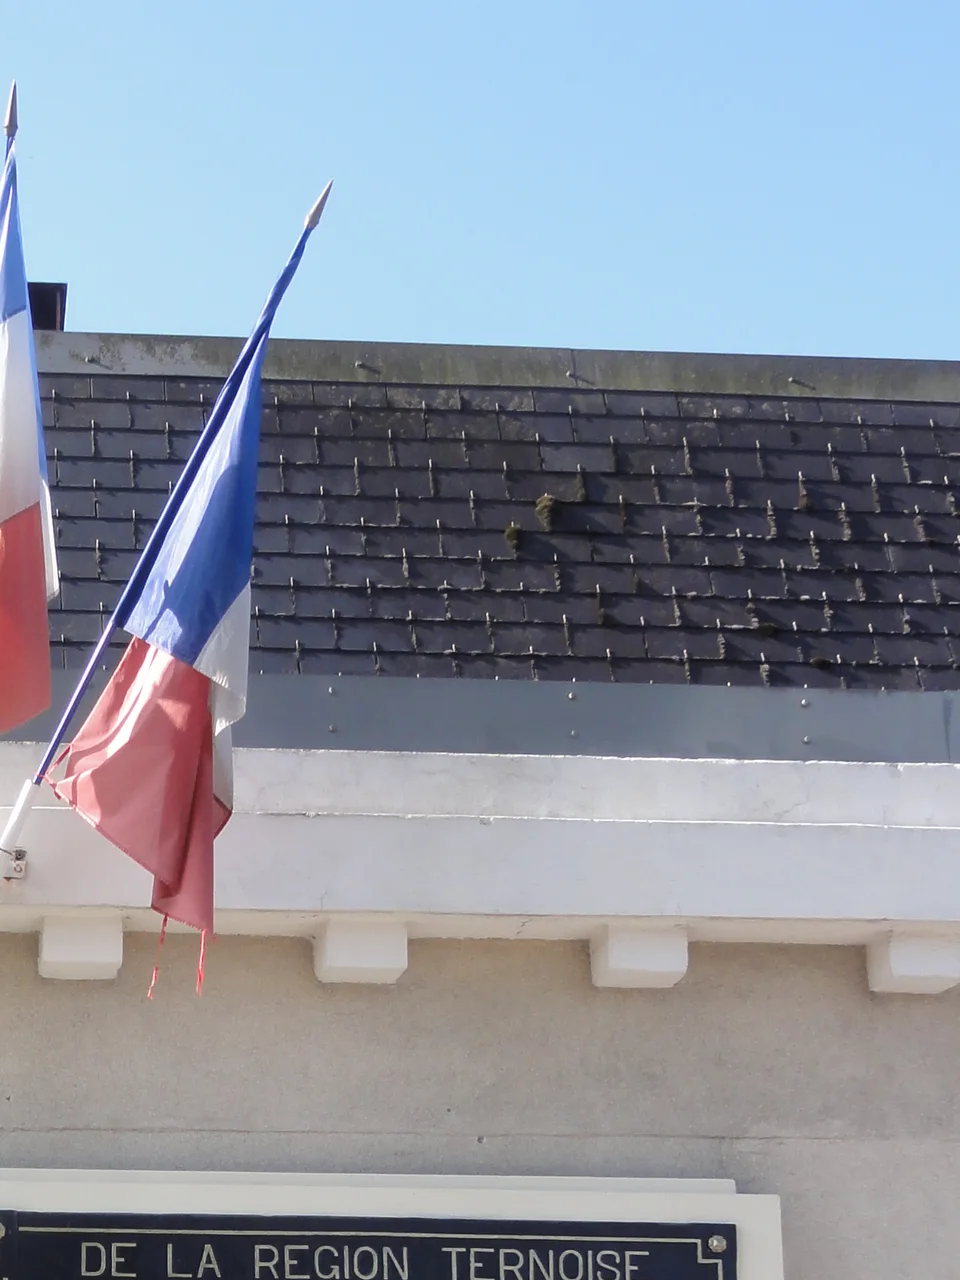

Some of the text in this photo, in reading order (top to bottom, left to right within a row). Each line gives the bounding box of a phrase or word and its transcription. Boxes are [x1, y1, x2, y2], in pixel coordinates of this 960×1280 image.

[81, 1242, 136, 1277] DE
[167, 1244, 221, 1277] LA
[255, 1245, 408, 1280] REGION
